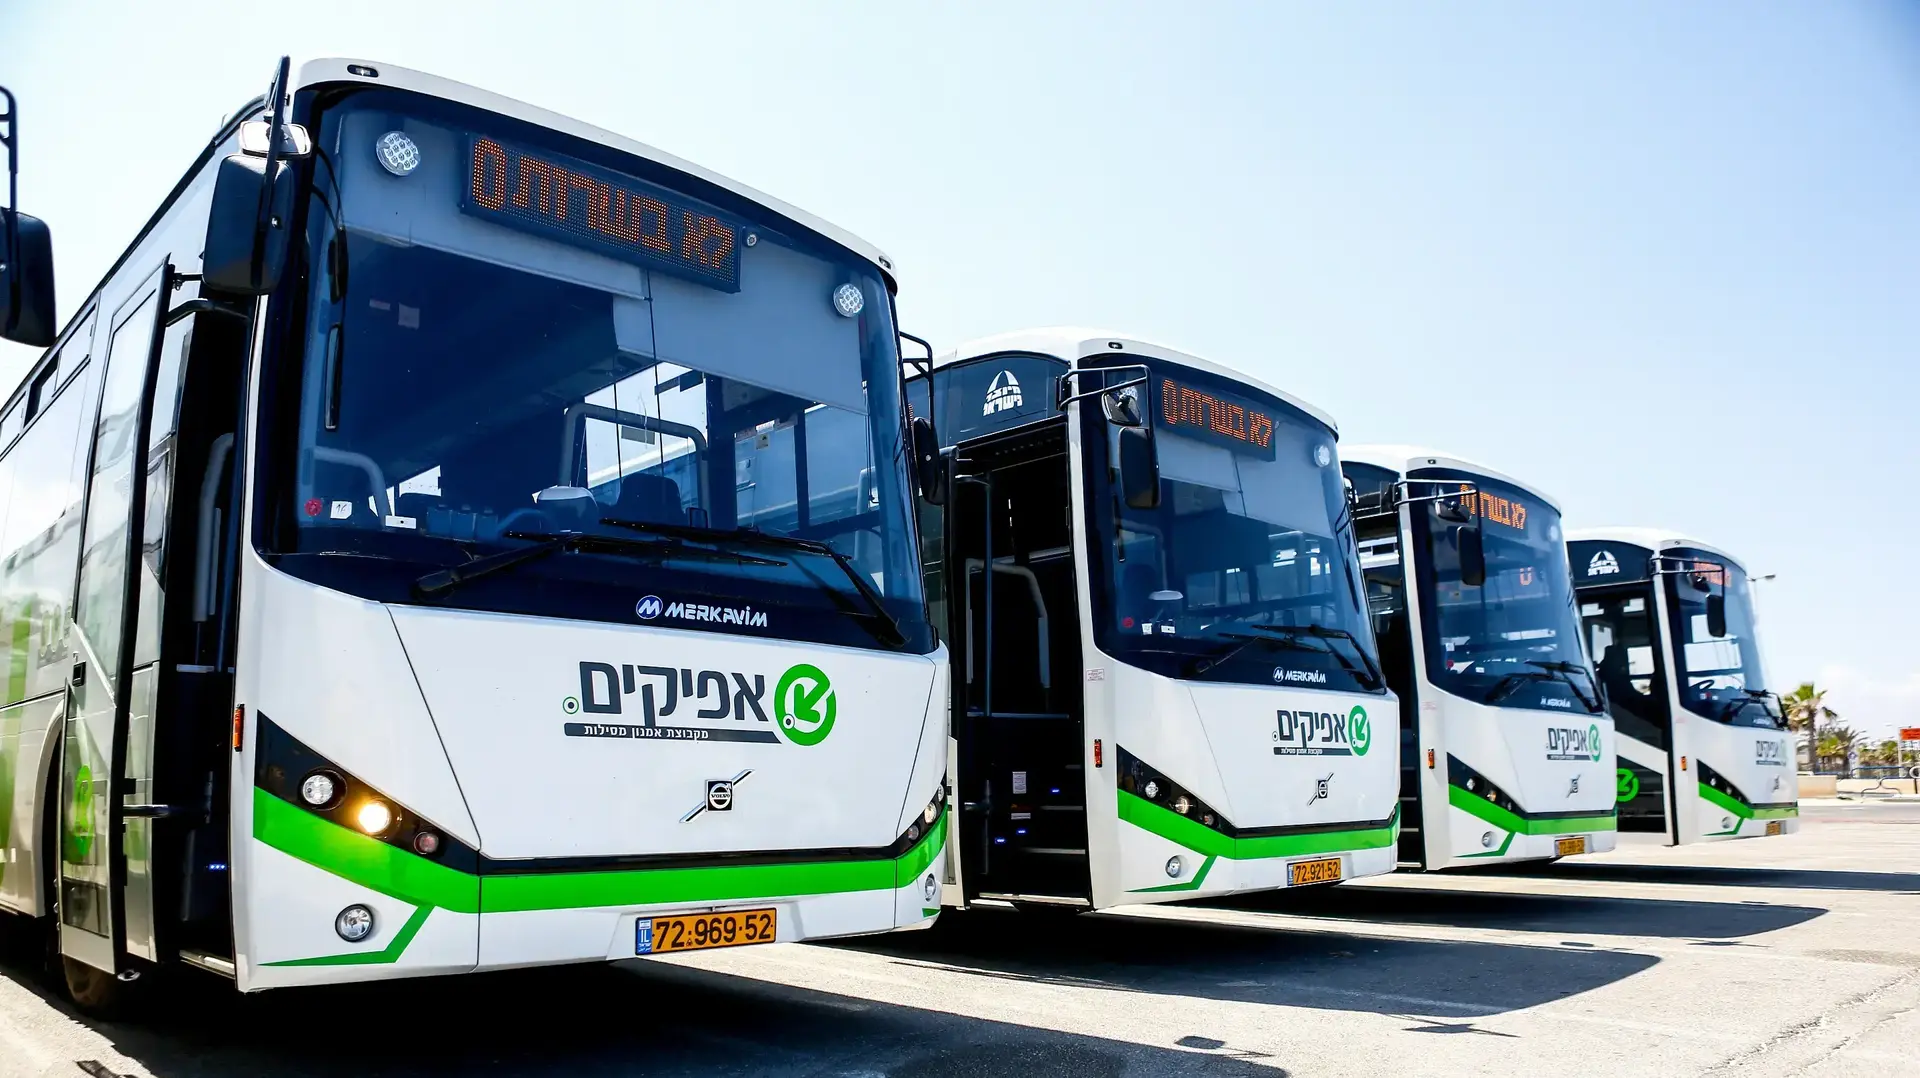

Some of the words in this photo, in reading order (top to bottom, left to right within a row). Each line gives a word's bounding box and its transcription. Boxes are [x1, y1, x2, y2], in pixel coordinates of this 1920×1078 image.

[513, 156, 671, 252] בשרות
[681, 211, 733, 268] לא
[1181, 387, 1246, 441] בשרות
[1248, 411, 1272, 448] לא
[1511, 503, 1526, 529] לא
[664, 601, 768, 627] MERKAVIM
[579, 661, 769, 727] אפיקים
[584, 724, 627, 736] מסילות
[632, 726, 662, 739] אמנון
[666, 727, 709, 740] מקבוצת
[1277, 710, 1347, 748] אפיקים
[640, 929, 650, 943] IL
